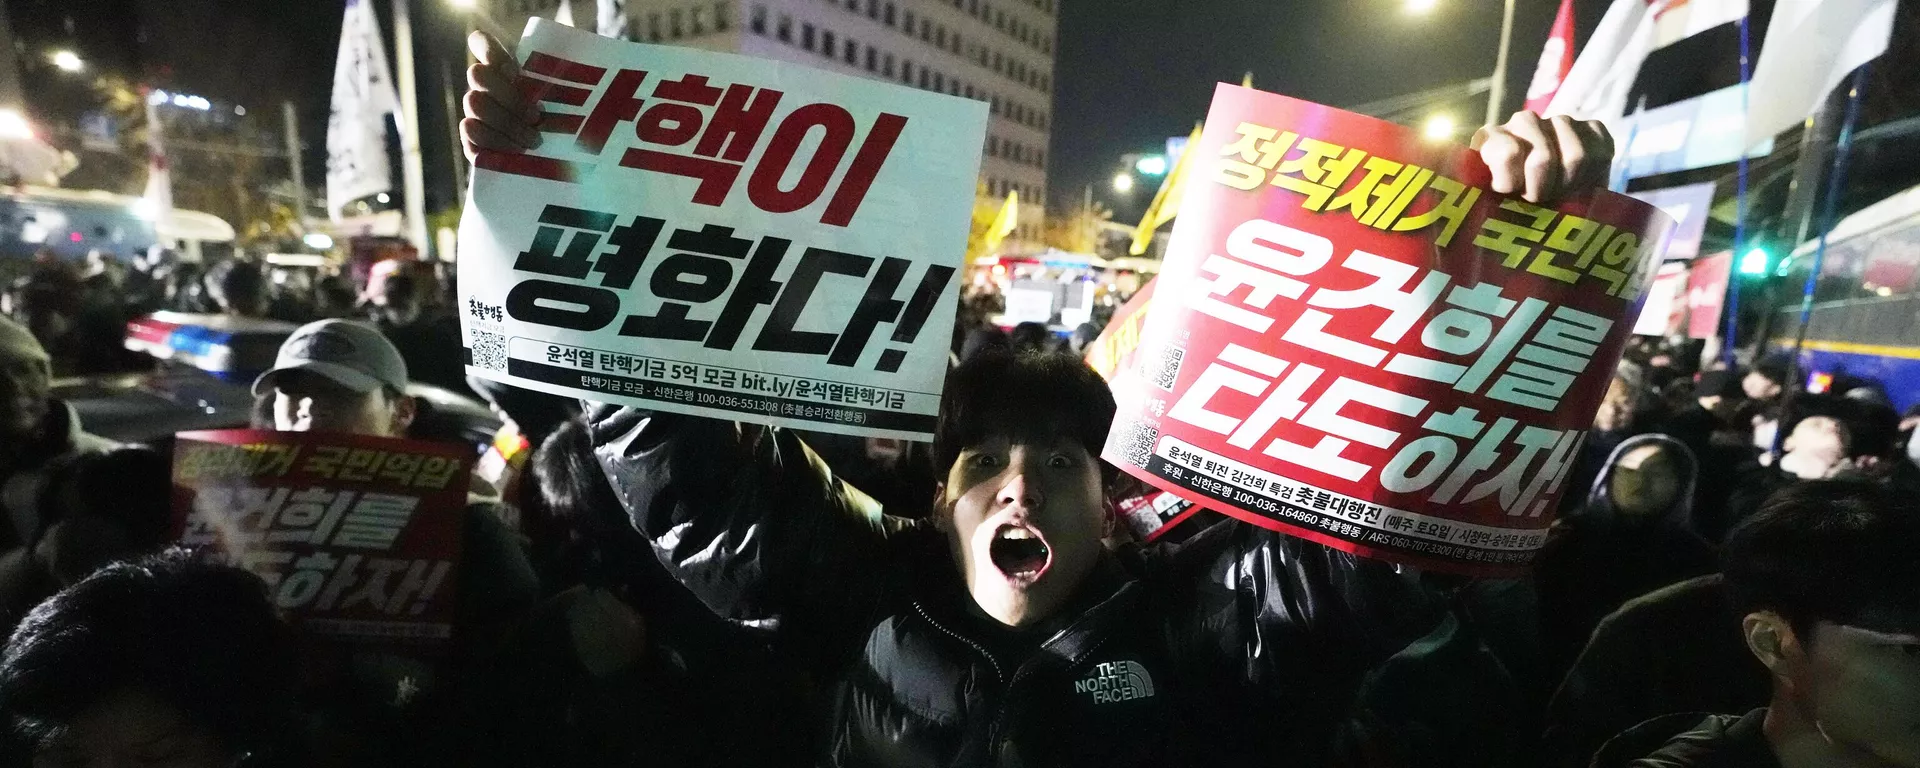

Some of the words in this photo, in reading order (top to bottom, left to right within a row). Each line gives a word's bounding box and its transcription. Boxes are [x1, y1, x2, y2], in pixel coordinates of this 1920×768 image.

[475, 50, 909, 227] 탄핵이
[1213, 120, 1482, 248] 정적제거
[469, 296, 503, 322] 촛불행동
[506, 204, 956, 372] 평화다!
[1194, 219, 1614, 412] 윤건희를
[546, 345, 595, 369] 윤석열
[600, 353, 666, 379] 탄핵기금
[671, 365, 700, 383] 5억
[702, 368, 737, 387] 모금
[741, 372, 906, 409] bit.ly/윤석열탄핵기금
[581, 375, 621, 392] 탄핵기금
[624, 383, 645, 395] 모금
[653, 387, 694, 401] 신한은행
[696, 392, 778, 412] 100-036-551308
[1166, 342, 1586, 518] 타도하자!
[1162, 463, 1184, 480] 후원
[1190, 472, 1233, 497] 신한은행
[1233, 490, 1318, 525] 100-036-164860
[1319, 517, 1362, 538] 촛불행동
[1368, 532, 1391, 545] ARS
[1391, 536, 1452, 556] 060-707-3300
[1168, 446, 1203, 468] 윤석열
[1204, 460, 1229, 478] 퇴진
[1231, 469, 1267, 491] 김건희
[1268, 481, 1294, 500] 특검
[1295, 486, 1383, 524] 촛불대행진
[1383, 514, 1414, 532] (매주
[1415, 520, 1451, 540] 토요일
[1075, 673, 1130, 693] NORTH
[1093, 687, 1132, 704] FACE
[1096, 661, 1128, 676] THE
